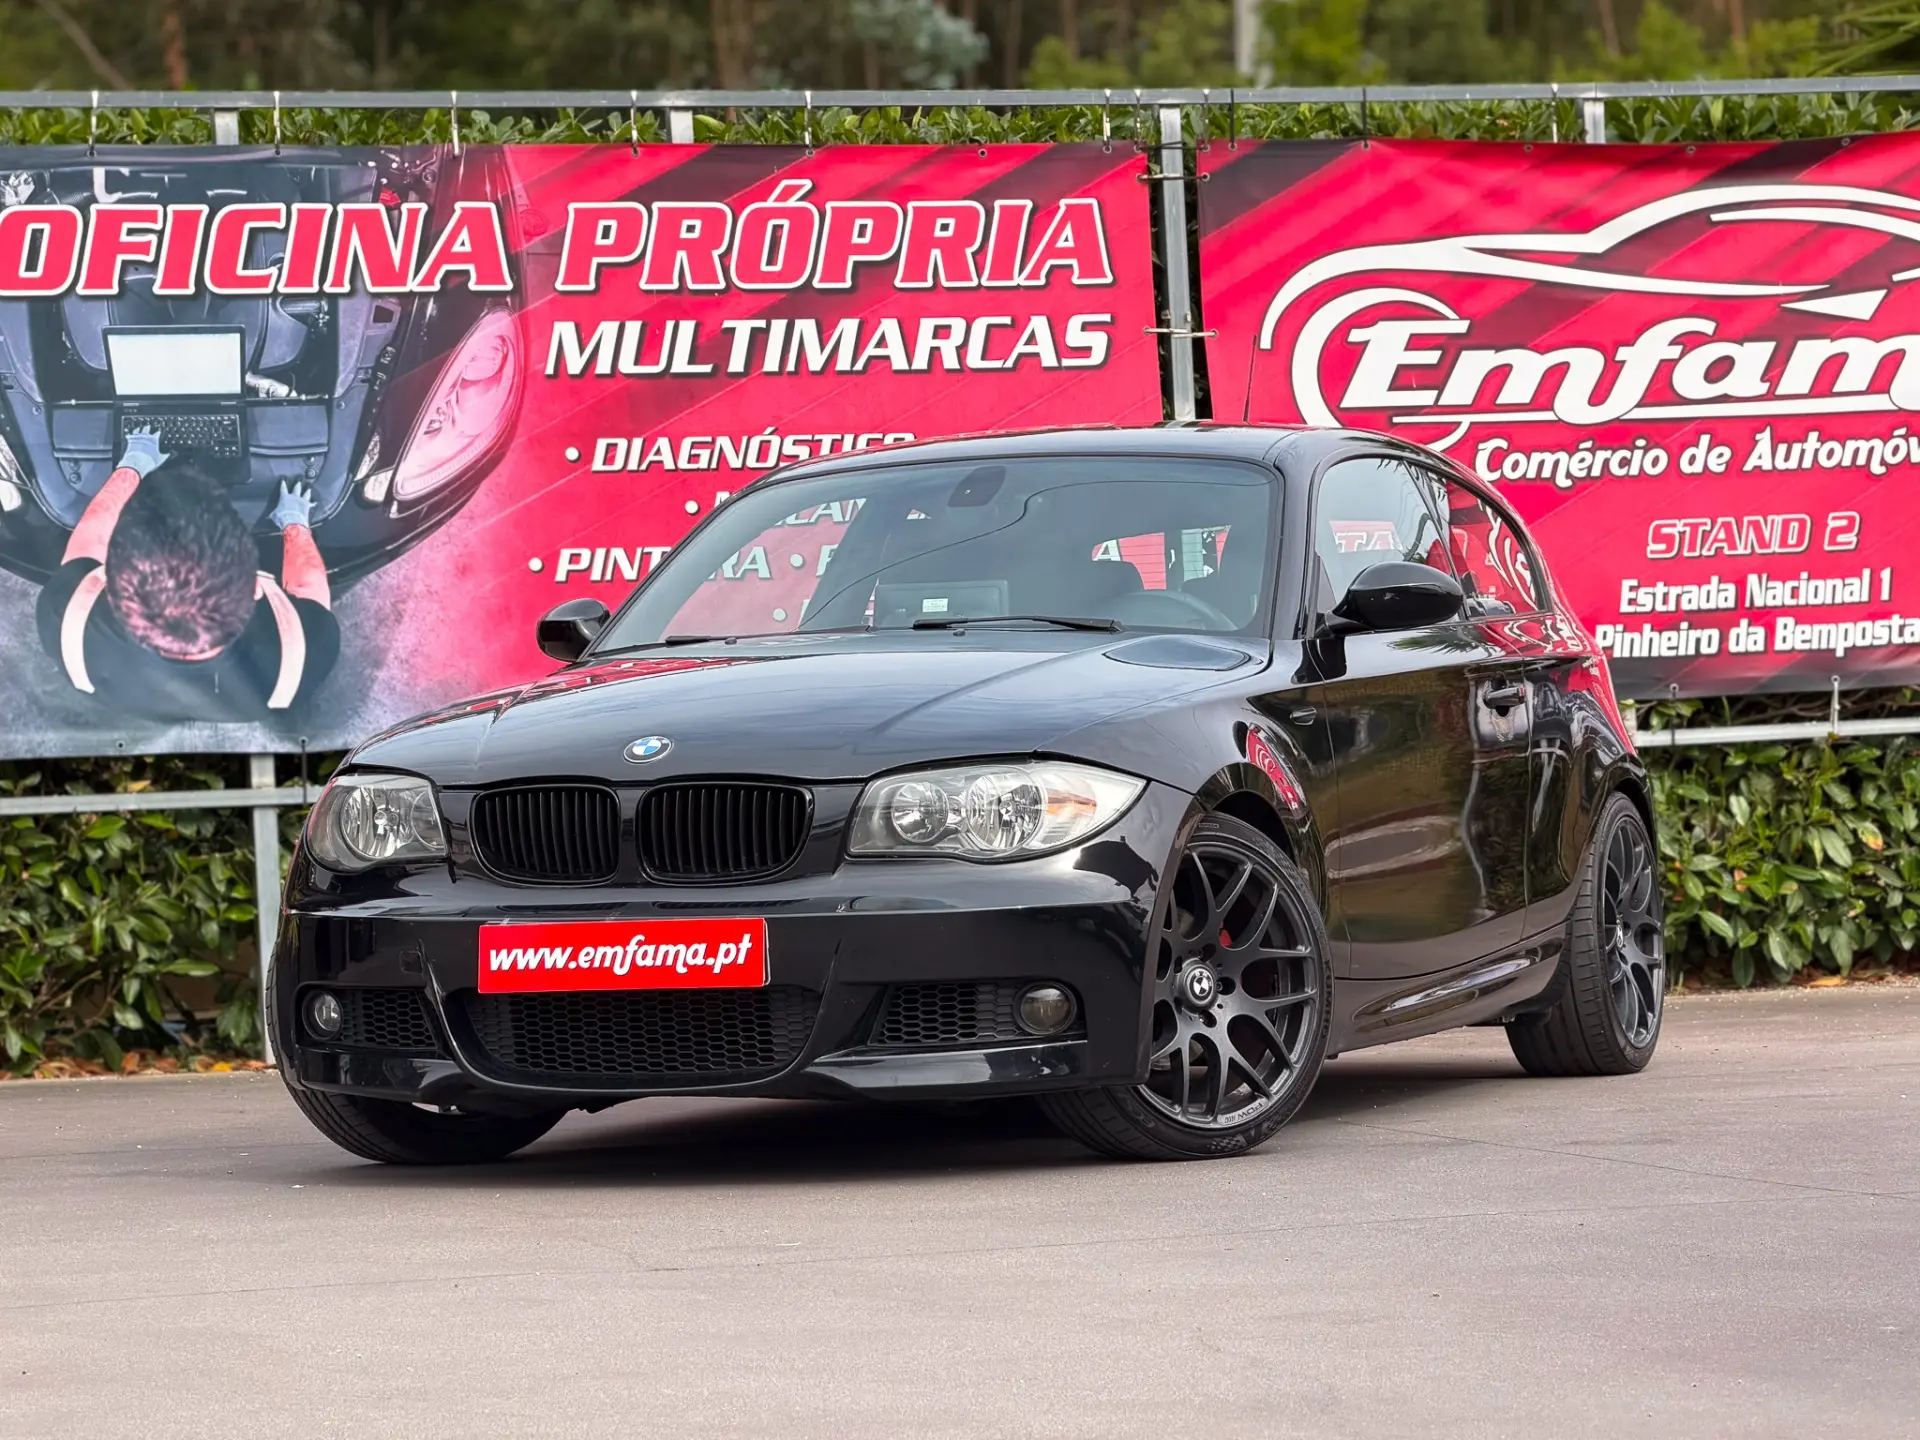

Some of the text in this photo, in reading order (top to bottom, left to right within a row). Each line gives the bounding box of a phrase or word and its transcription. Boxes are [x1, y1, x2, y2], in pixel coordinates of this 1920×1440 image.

[0, 179, 1114, 297] OFICINA PRÓPRIA
[544, 314, 1112, 376] MULTIMARCAS
[1339, 317, 1920, 424] Emfam
[591, 427, 915, 472] DIAGNÓSTI
[1475, 438, 1669, 488] Comércio
[1679, 434, 1733, 475] de
[1646, 511, 1861, 559] STAND 2
[1619, 567, 1893, 613] Estrada Nacional 1
[1595, 614, 1920, 659] Pinheiro da Bemposta
[489, 933, 752, 976] www.emfama.pt
